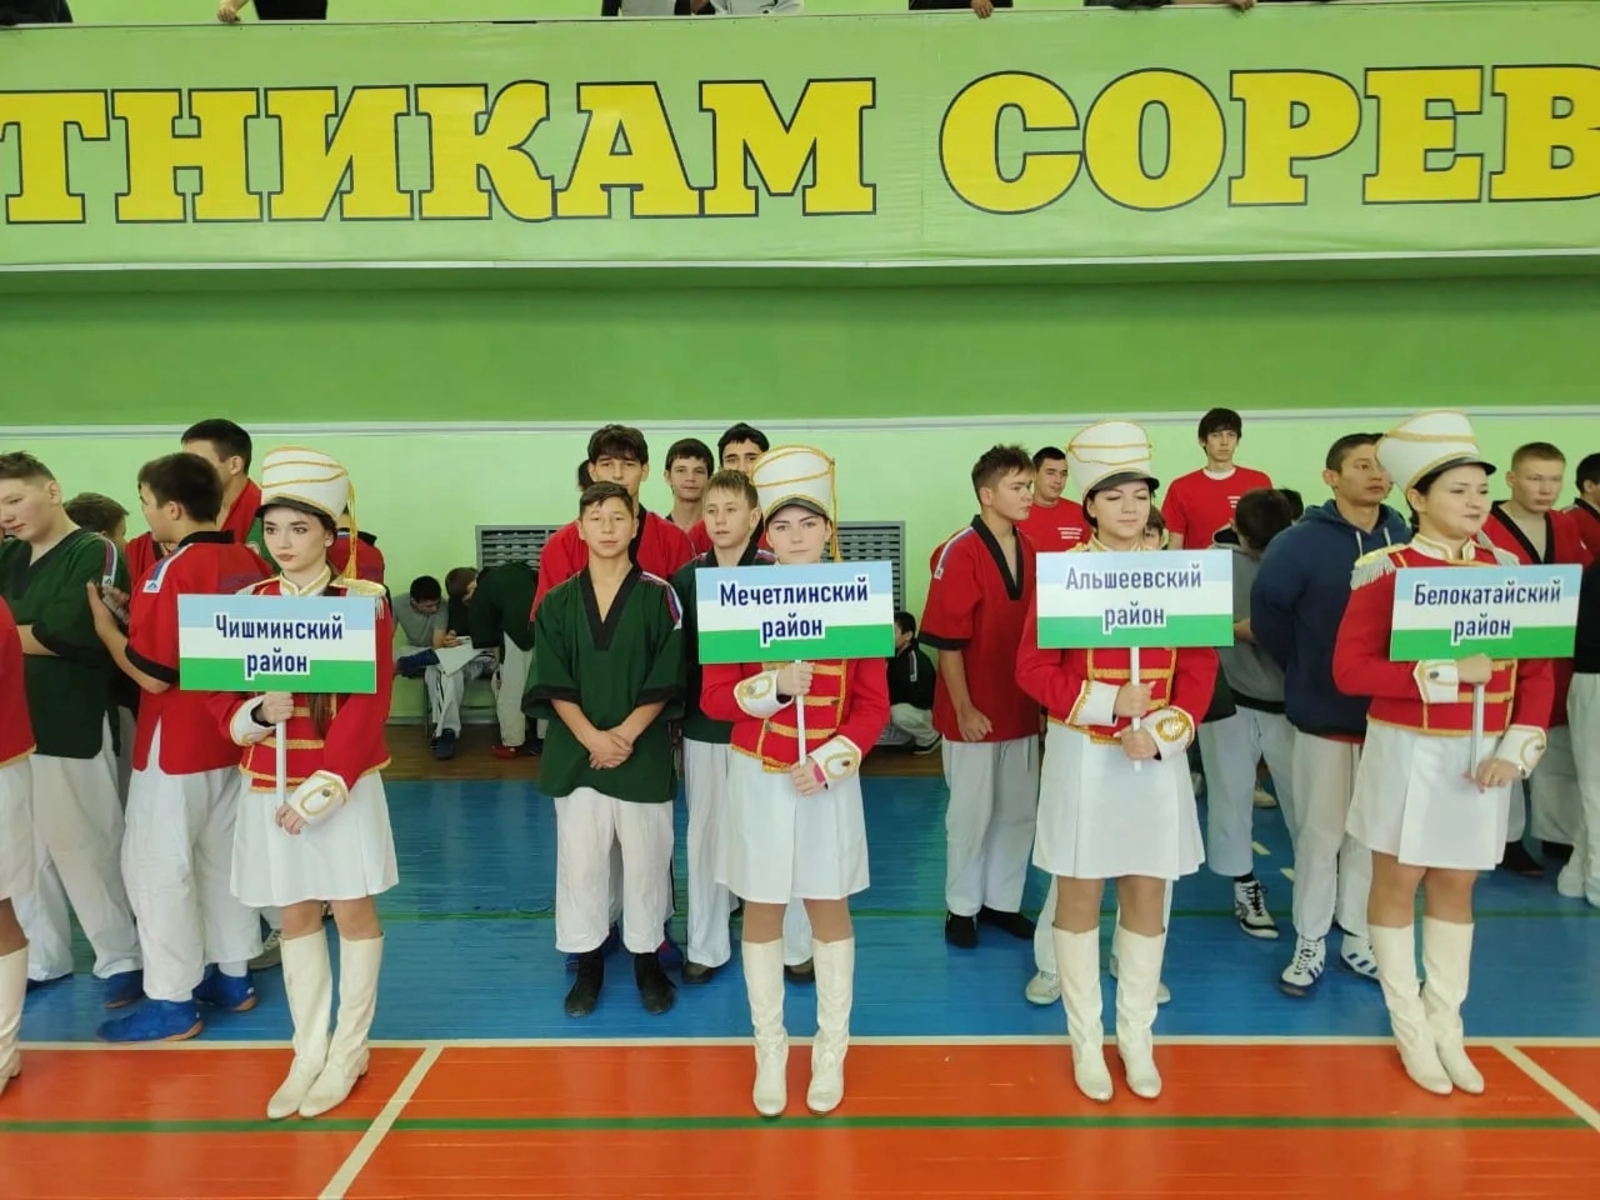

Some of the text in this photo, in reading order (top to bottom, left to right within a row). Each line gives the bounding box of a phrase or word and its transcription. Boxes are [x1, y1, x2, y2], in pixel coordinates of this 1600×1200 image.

[0, 64, 1600, 223] ТНИКАМ СОРЕВ
[720, 576, 868, 607] Мечетлинский
[1066, 563, 1202, 590] Альшеевский
[1414, 579, 1561, 606] Белокатайский
[215, 614, 343, 640] Чишминский
[762, 612, 823, 644] район
[1104, 600, 1164, 631] район
[1453, 613, 1511, 642] район
[247, 647, 308, 678] район
